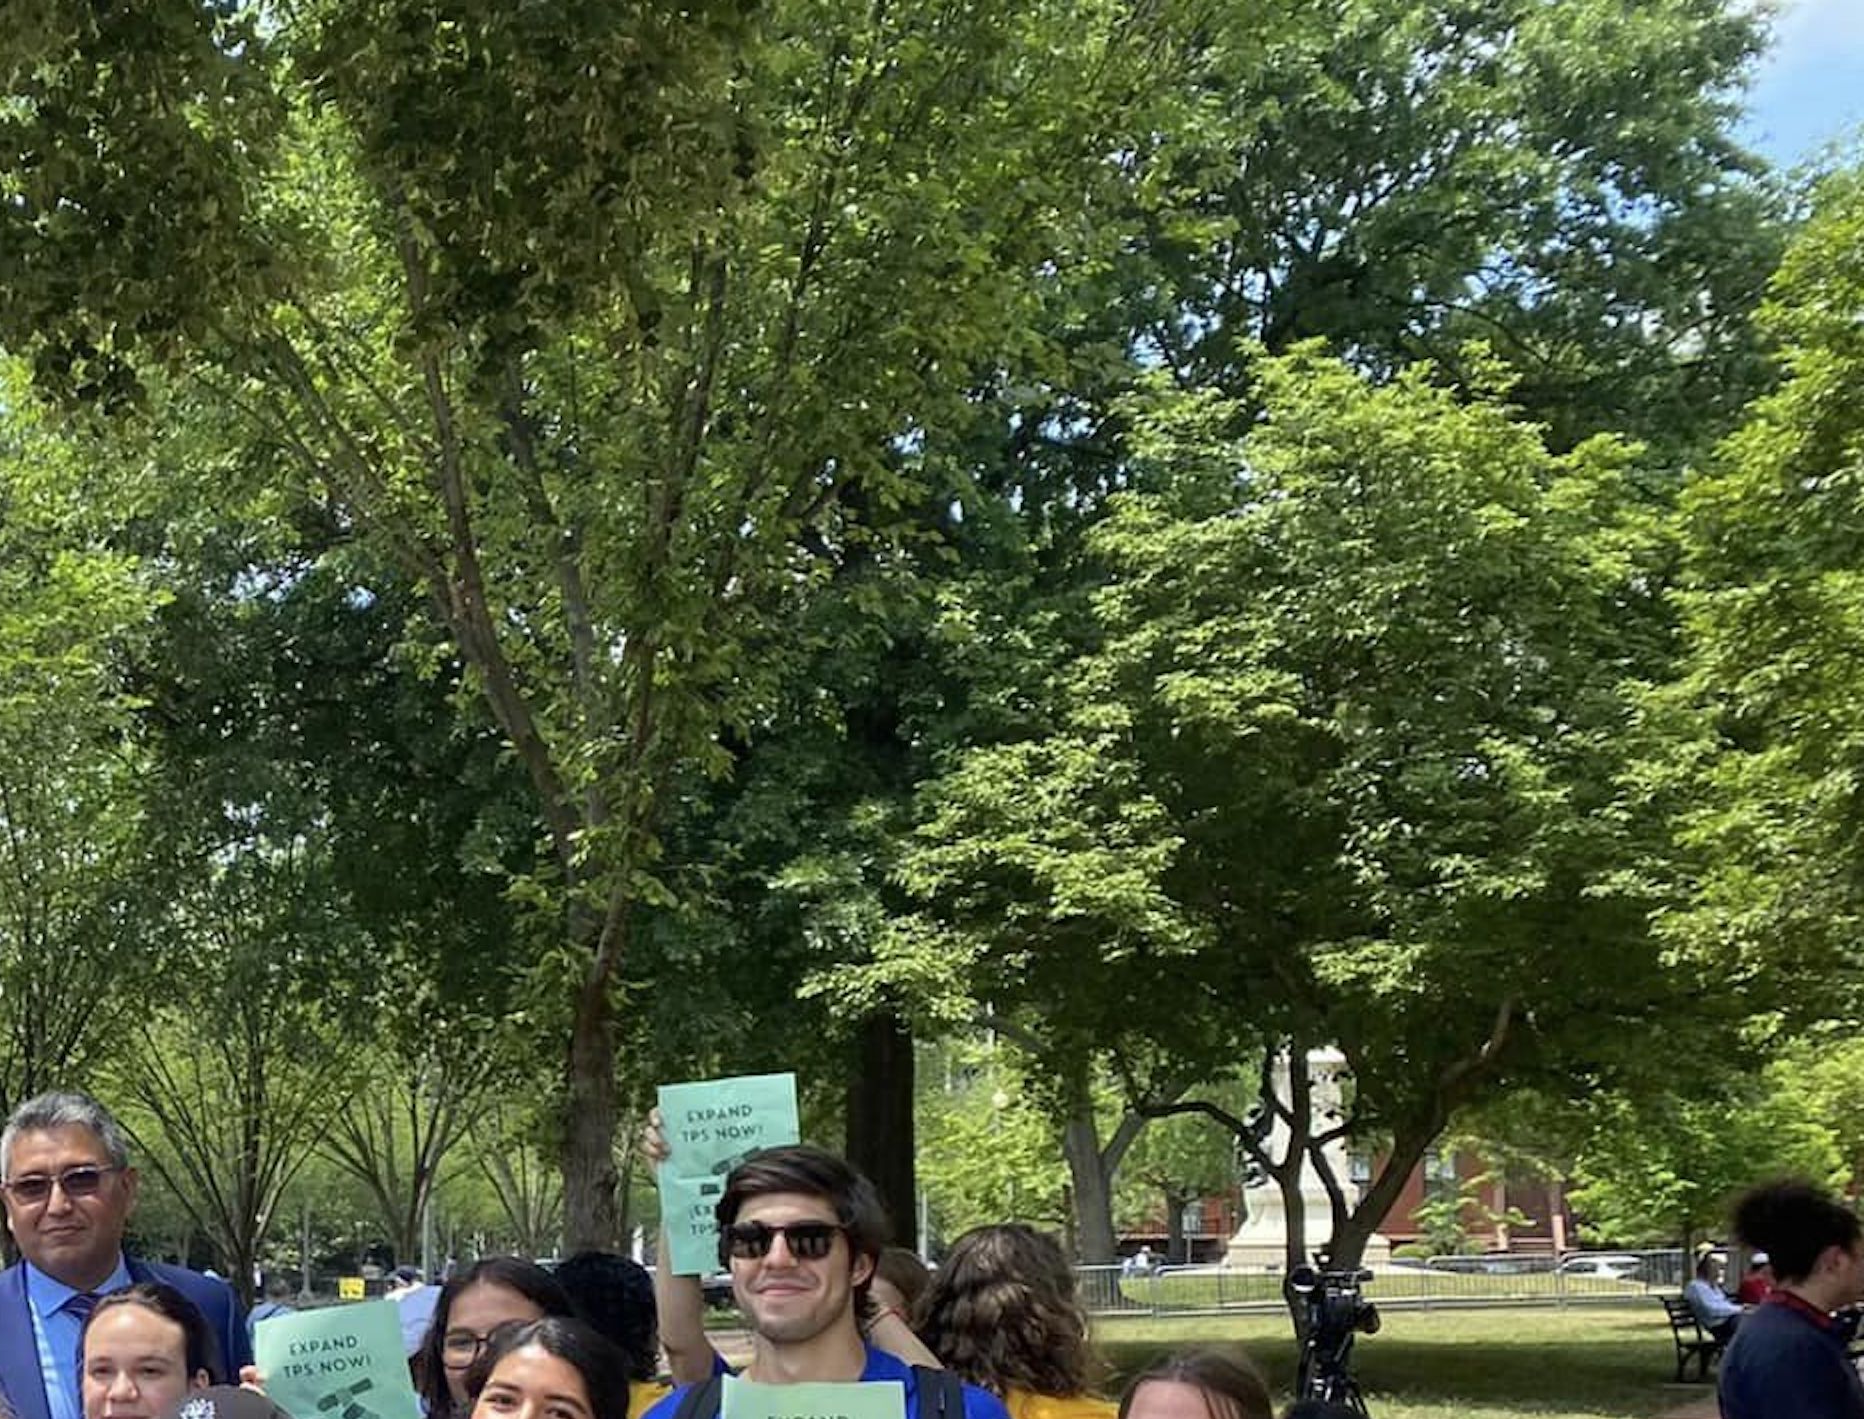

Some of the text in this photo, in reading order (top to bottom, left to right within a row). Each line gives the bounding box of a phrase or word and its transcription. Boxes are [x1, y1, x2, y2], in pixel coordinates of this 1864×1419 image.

[687, 1104, 753, 1124] EXPAND
[681, 1124, 766, 1143] TPS NOW!
[289, 1335, 358, 1356] EXPAND
[283, 1354, 372, 1378] TPS NOW!
